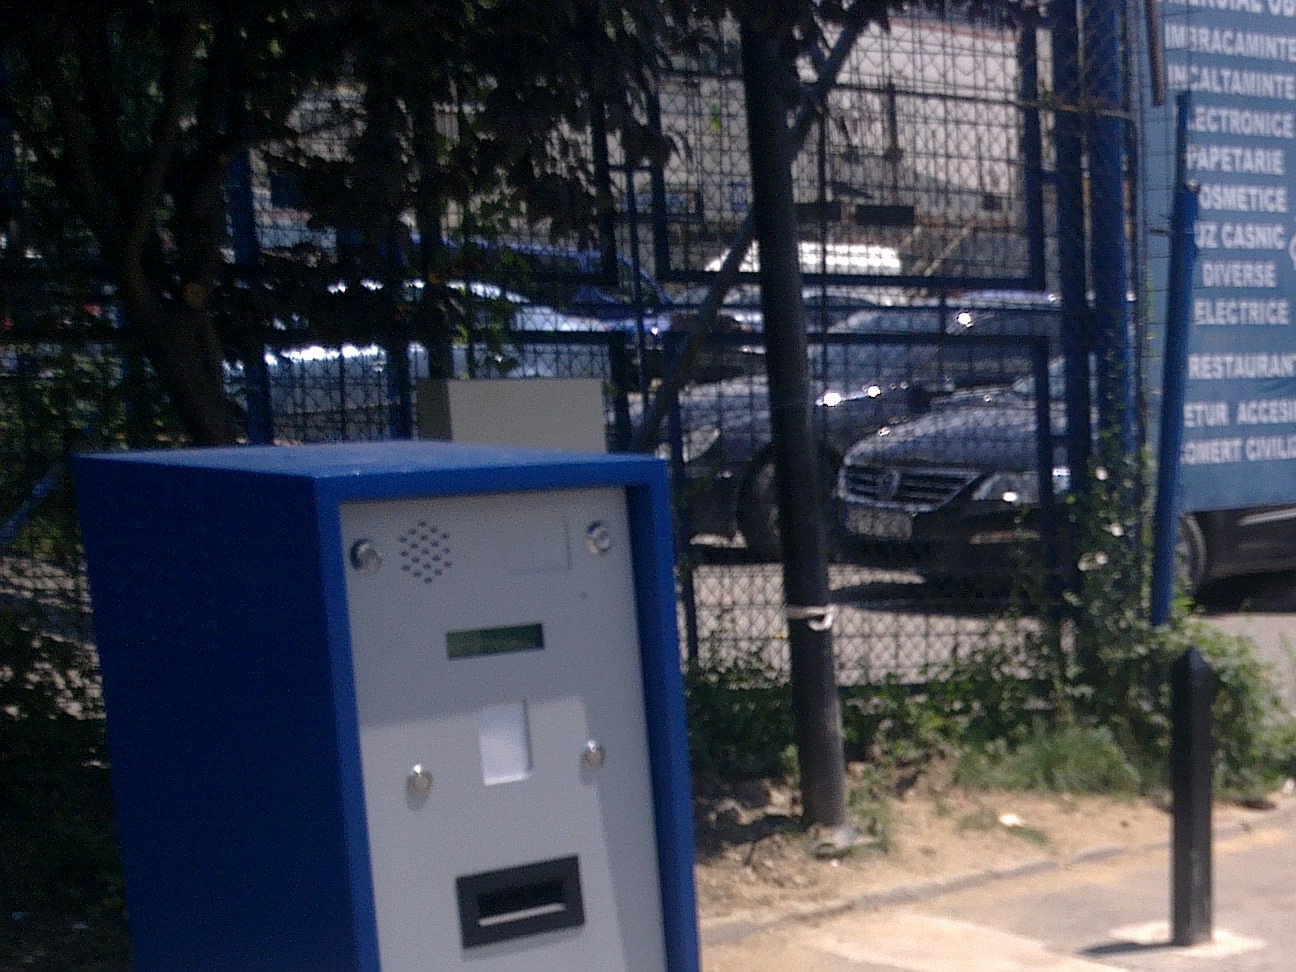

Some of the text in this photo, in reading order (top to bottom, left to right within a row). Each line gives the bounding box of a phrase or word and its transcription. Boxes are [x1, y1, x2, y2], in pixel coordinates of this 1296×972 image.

[1186, 105, 1296, 139] ECTRONICE
[1198, 183, 1289, 214] OSMETICE
[1220, 221, 1287, 250] CASNIC
[1203, 260, 1277, 288] DIVERSE
[1193, 299, 1290, 326] ELECTRICE
